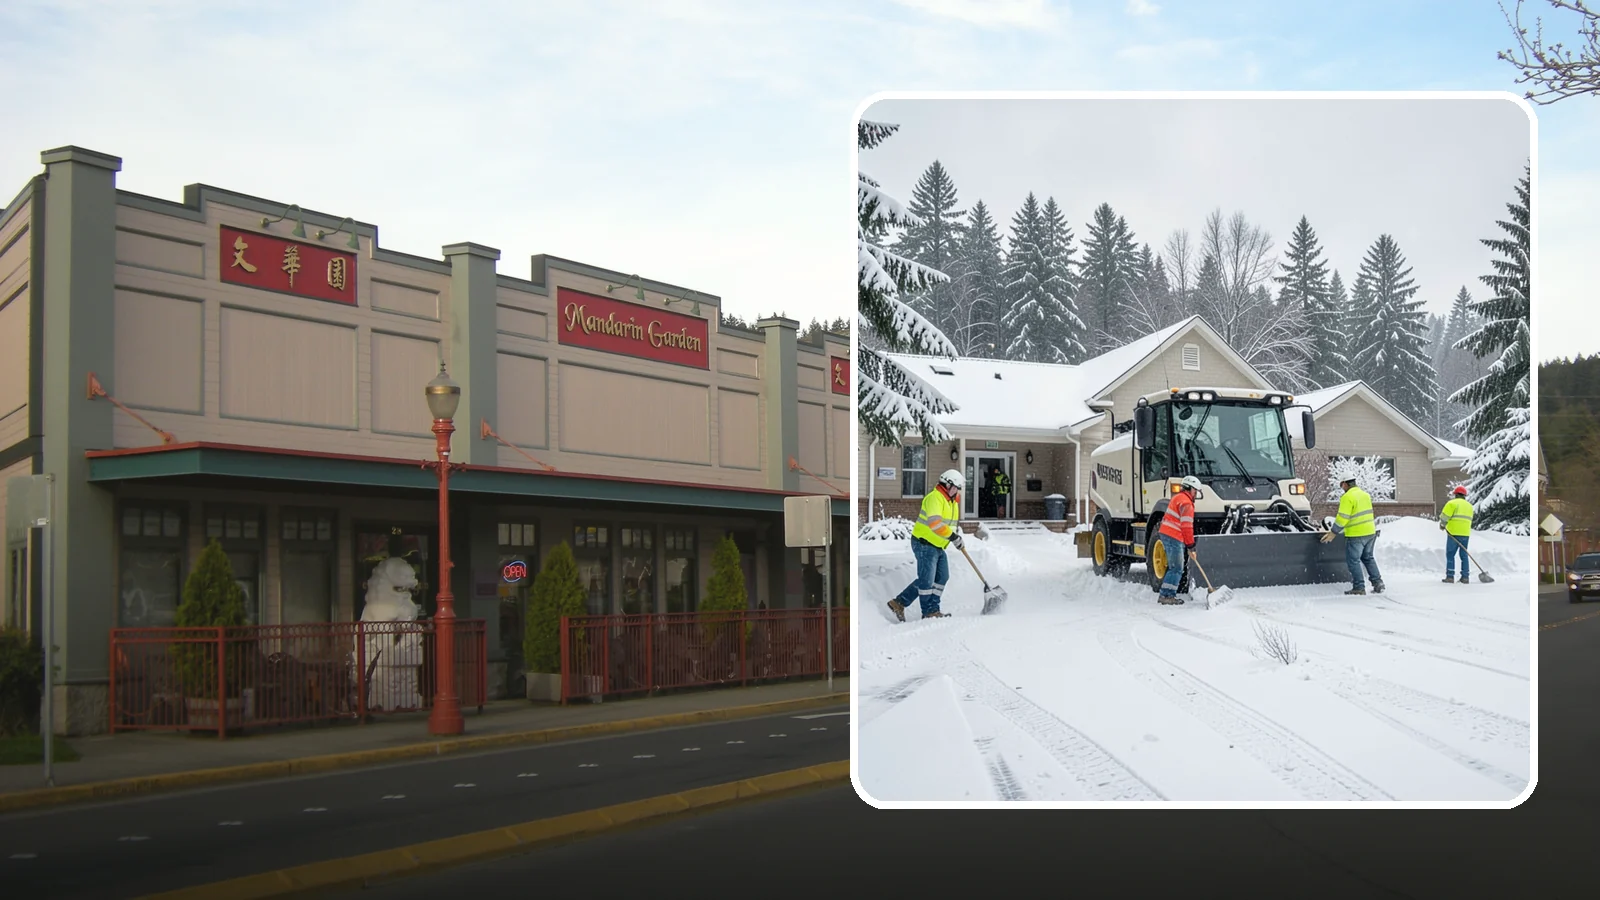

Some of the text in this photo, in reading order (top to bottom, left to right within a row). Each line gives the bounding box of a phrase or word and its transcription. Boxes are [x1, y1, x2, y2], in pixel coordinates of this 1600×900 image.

[564, 302, 702, 352] Mandarin Garden
[503, 565, 527, 579] OPEN
